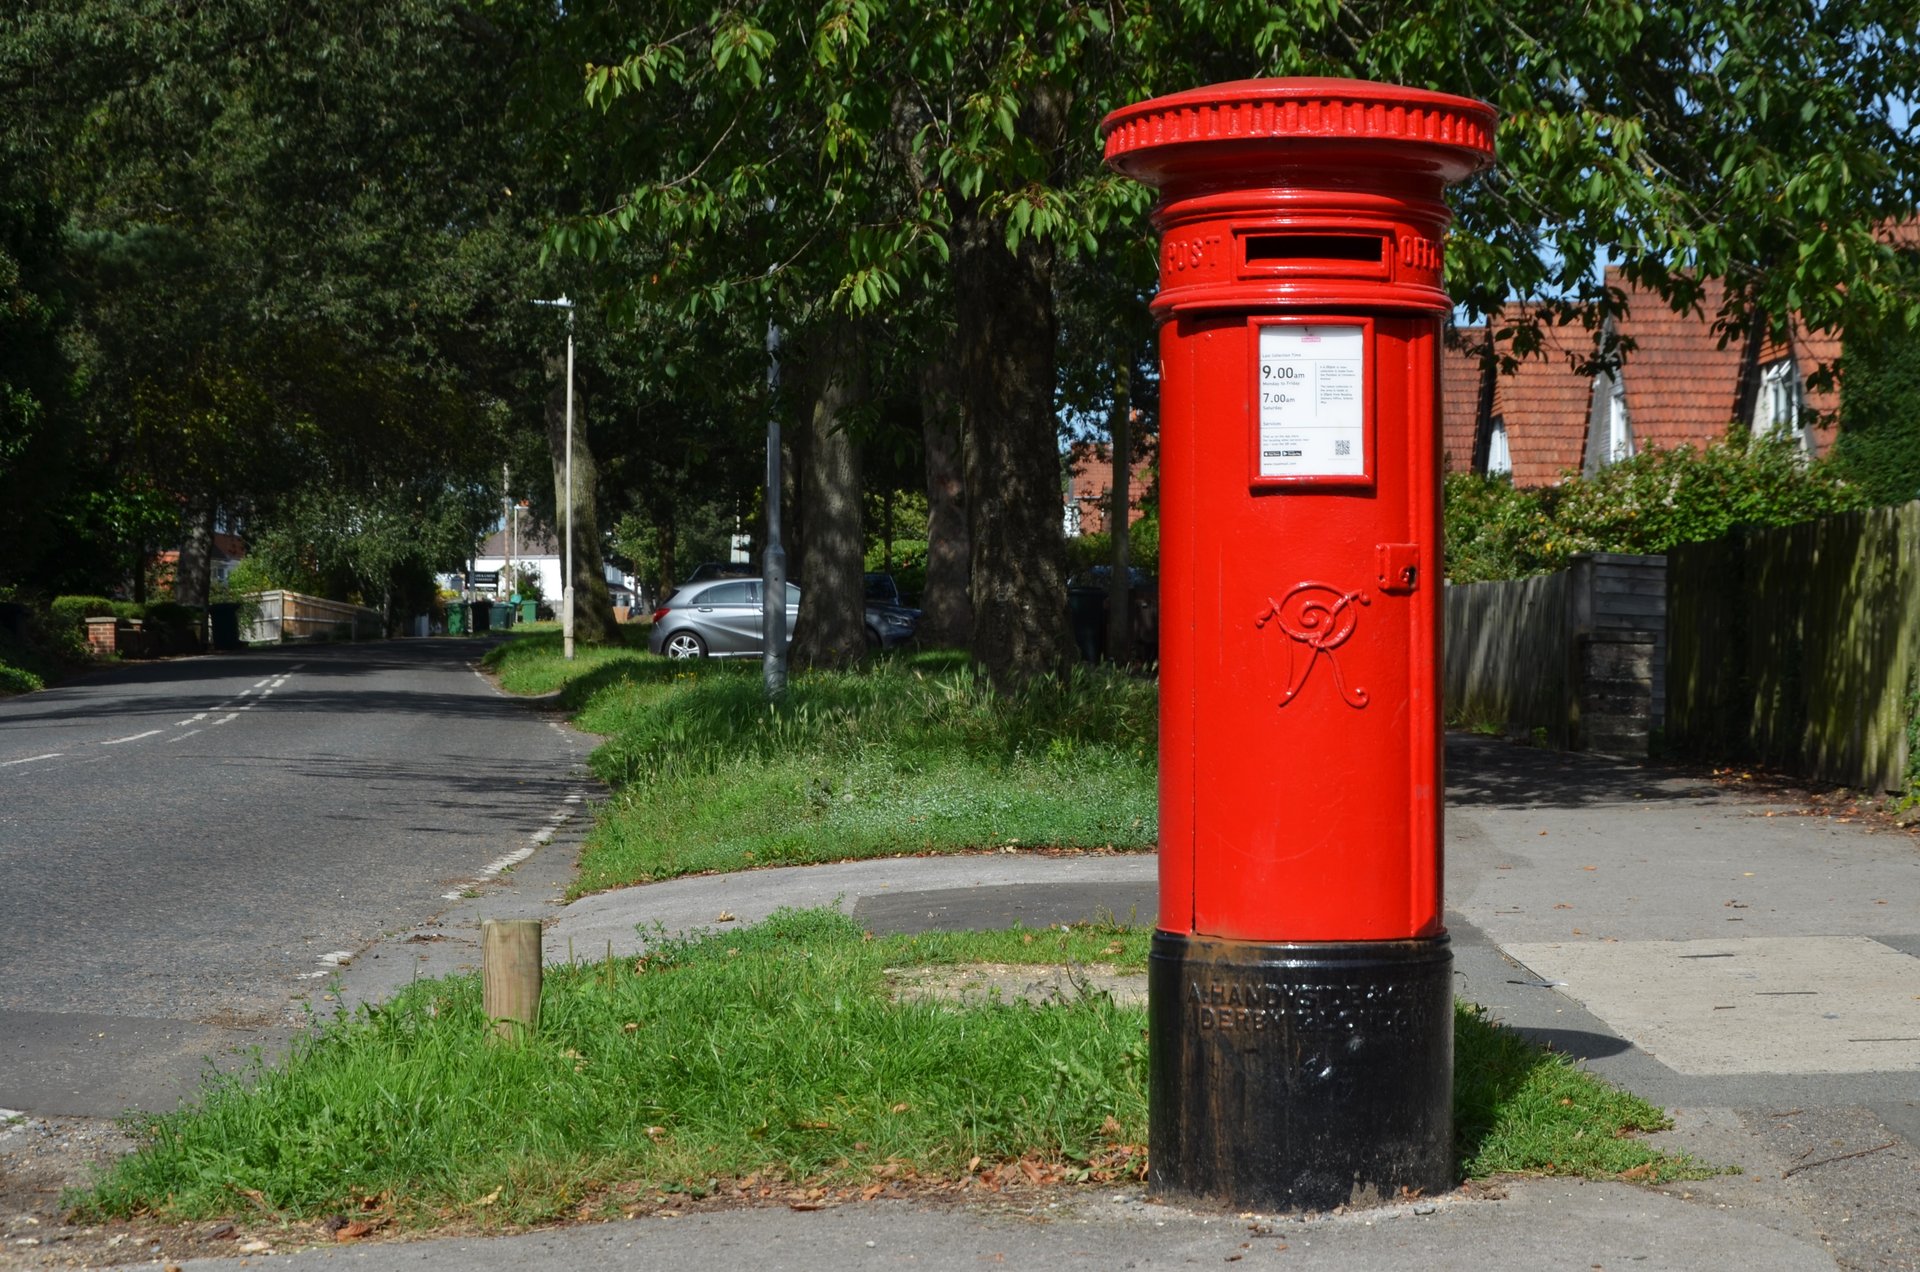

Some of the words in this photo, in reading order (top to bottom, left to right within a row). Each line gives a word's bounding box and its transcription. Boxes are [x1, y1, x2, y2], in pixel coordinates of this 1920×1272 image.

[1167, 235, 1222, 274] POST
[1262, 365, 1305, 379] 9.00am
[1263, 392, 1295, 403] 7.00am
[1201, 1006, 1285, 1031] DERBY
